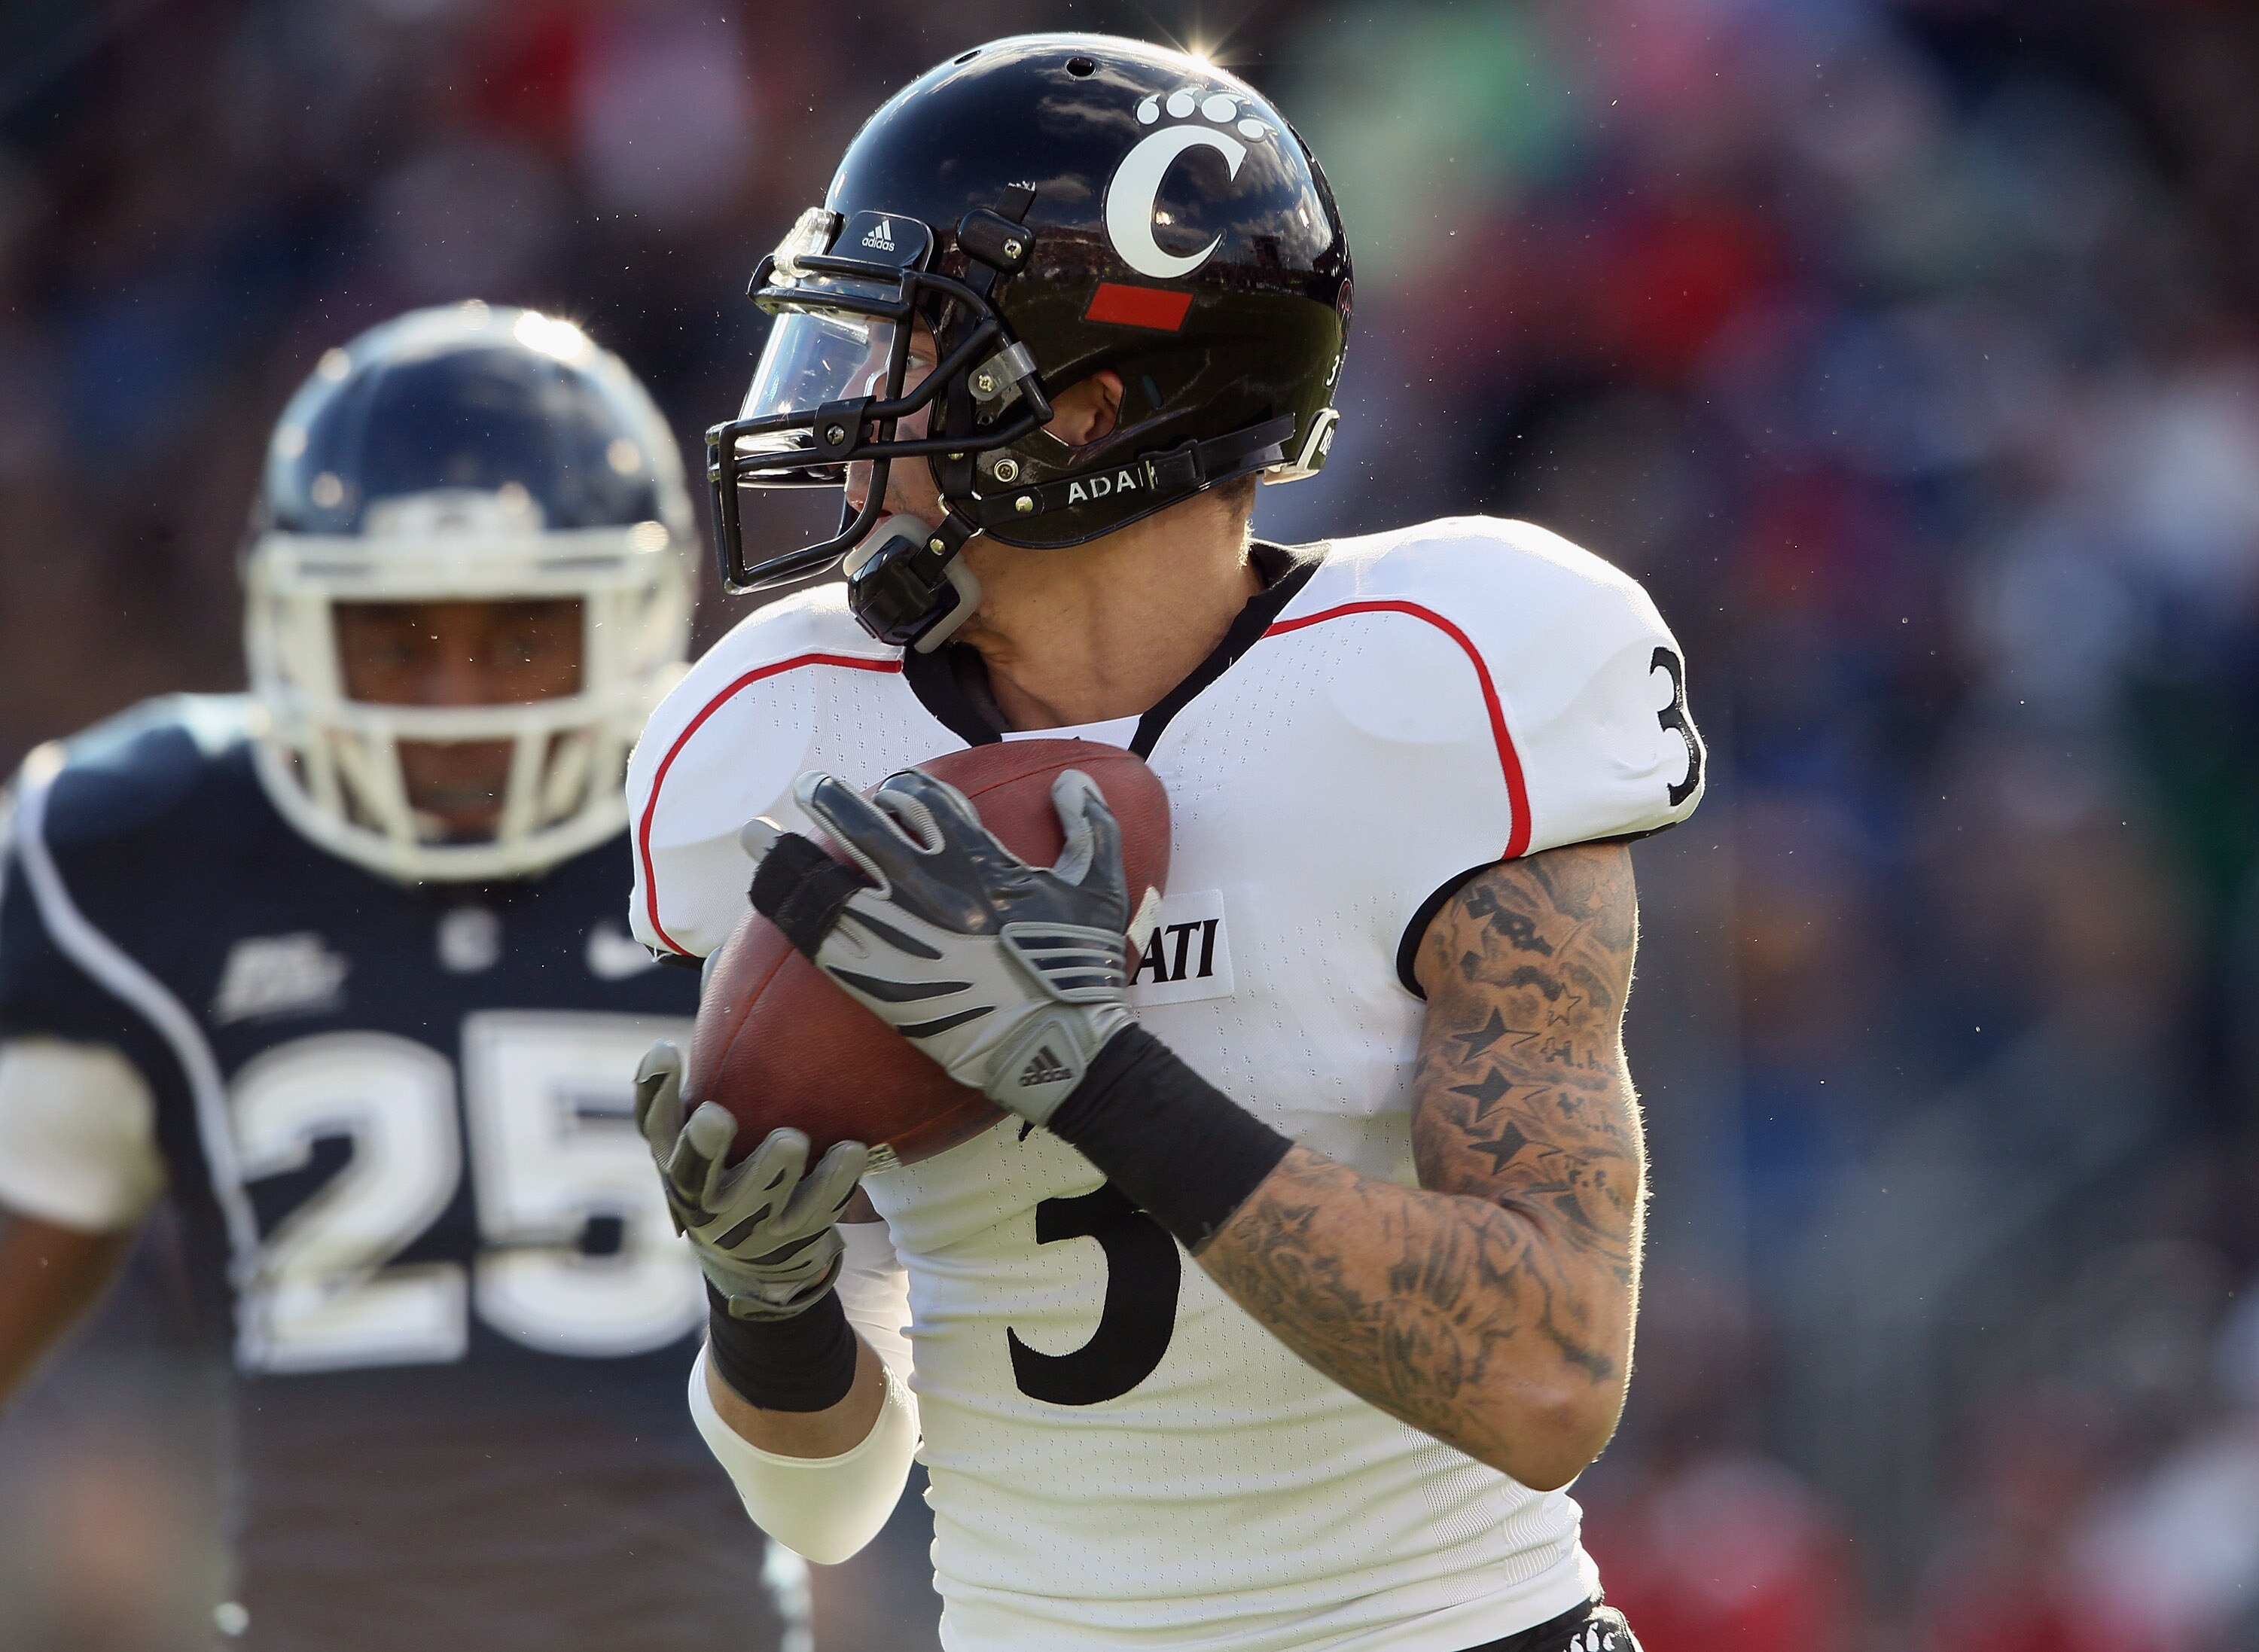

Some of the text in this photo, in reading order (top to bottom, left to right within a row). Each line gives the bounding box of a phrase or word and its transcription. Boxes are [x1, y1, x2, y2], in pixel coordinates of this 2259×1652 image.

[861, 236, 895, 251] adidas
[1105, 124, 1248, 279] C
[1649, 646, 1701, 806] 3
[1019, 1068, 1074, 1087] adidas
[228, 1009, 706, 1369] 25
